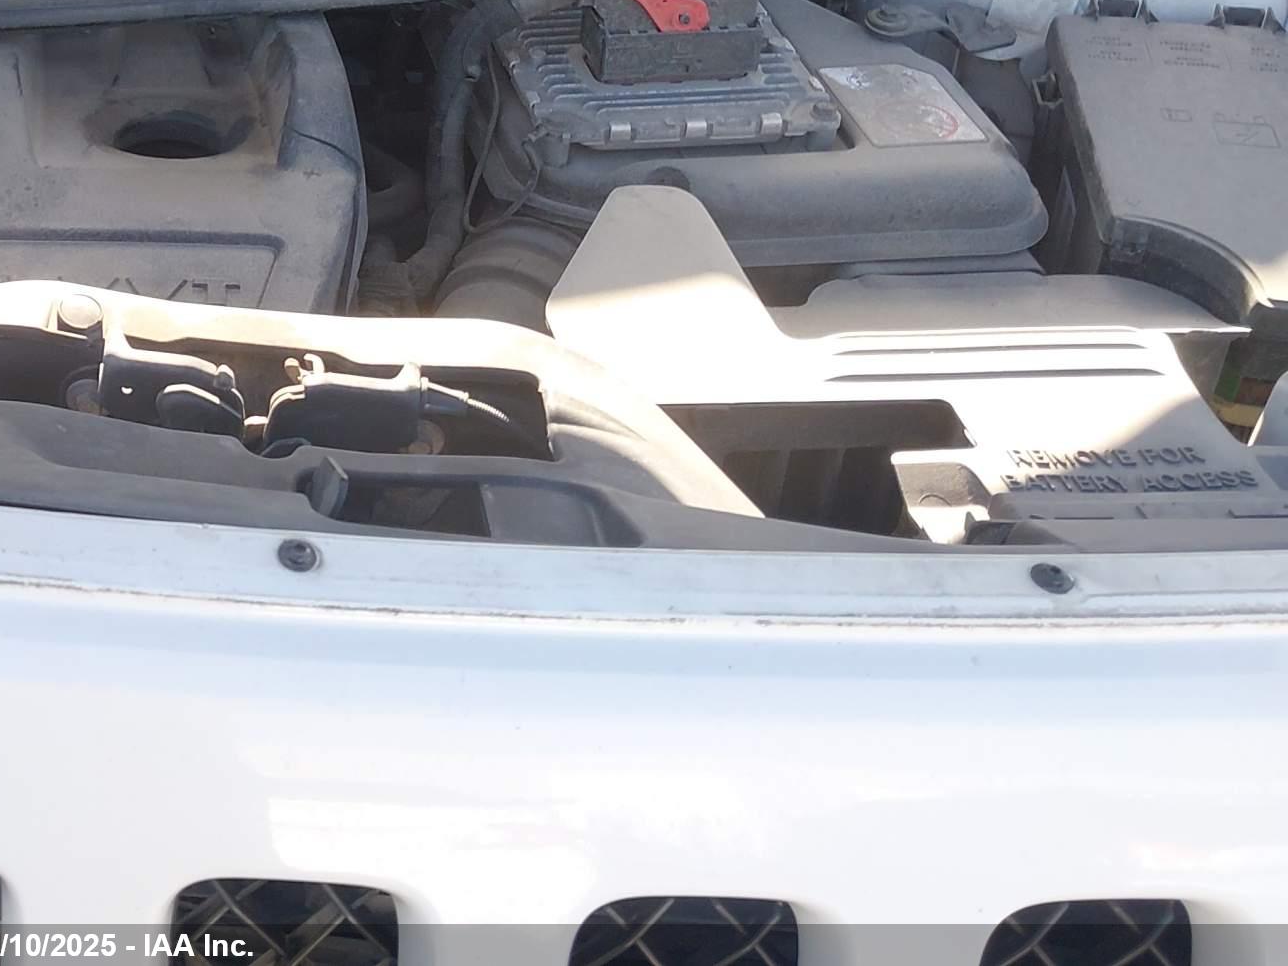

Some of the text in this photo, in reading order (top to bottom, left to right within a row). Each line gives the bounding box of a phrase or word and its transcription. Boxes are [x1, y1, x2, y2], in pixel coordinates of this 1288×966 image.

[1006, 446, 1206, 469] REMOVE FOR
[999, 470, 1259, 493] BATTERY ACCESS
